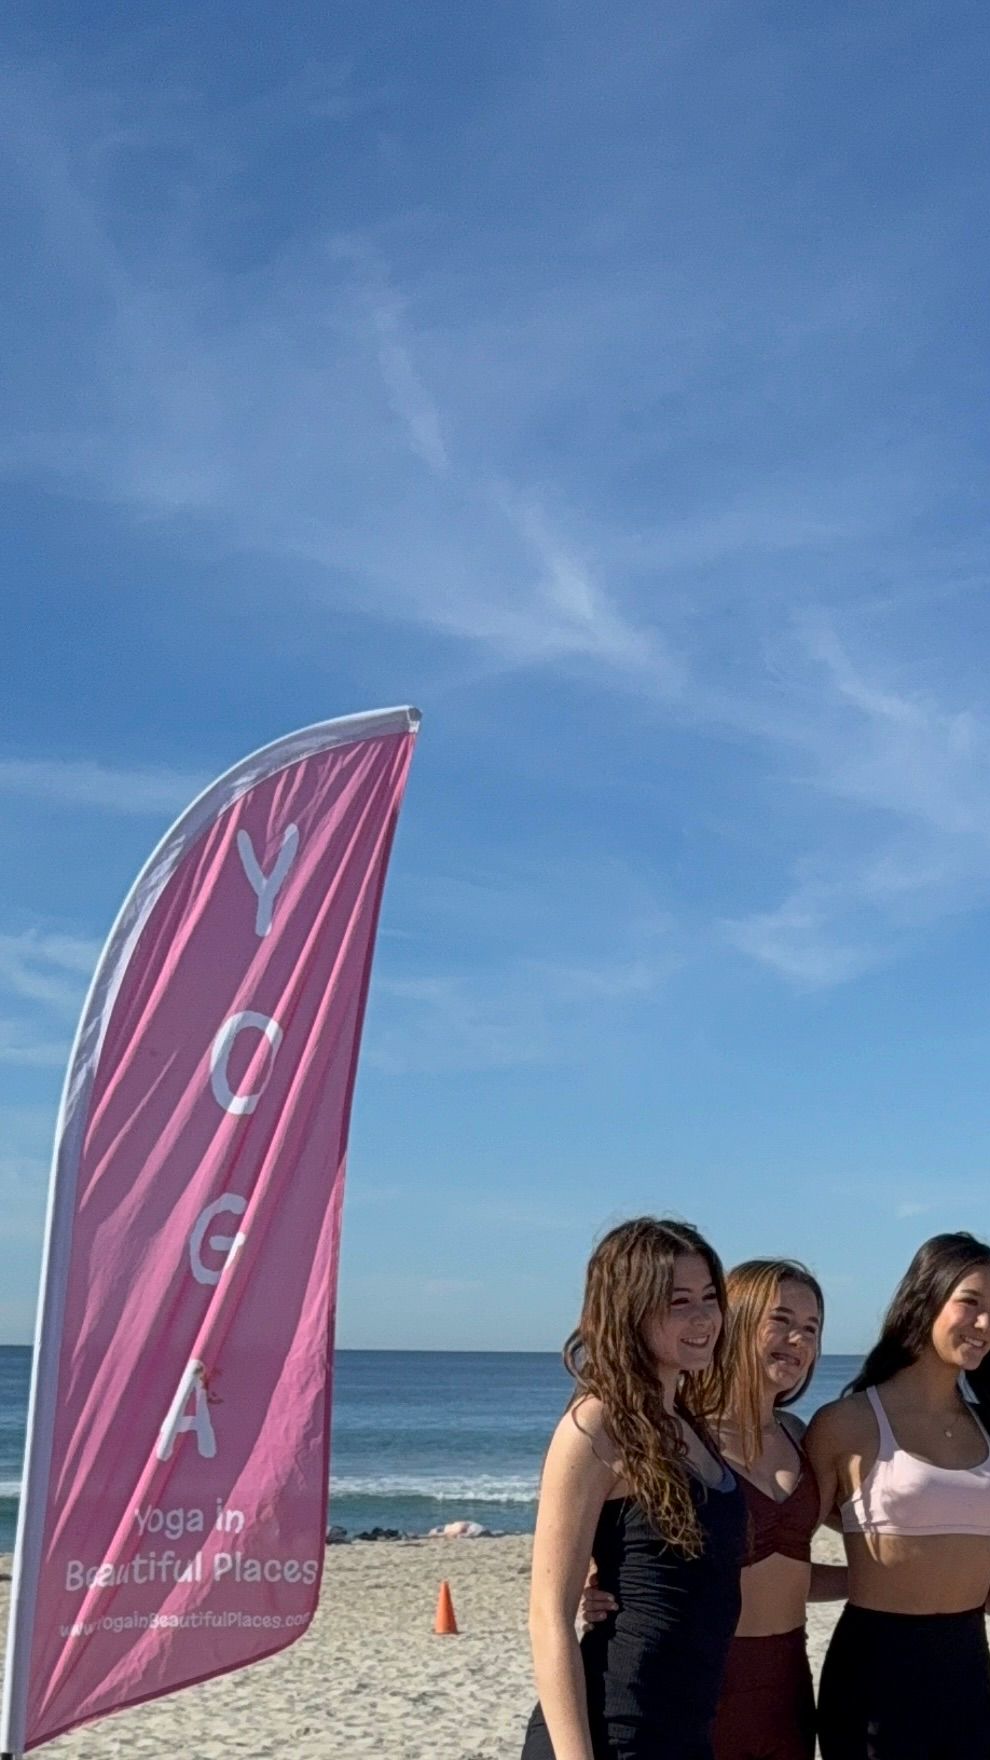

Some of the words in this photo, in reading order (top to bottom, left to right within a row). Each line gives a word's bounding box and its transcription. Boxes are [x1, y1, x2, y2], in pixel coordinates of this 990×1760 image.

[156, 822, 299, 1462] YOGA
[134, 1504, 204, 1540] Yoga
[215, 1497, 245, 1534] in
[64, 1551, 202, 1592] Beautiful
[213, 1551, 319, 1585] Places
